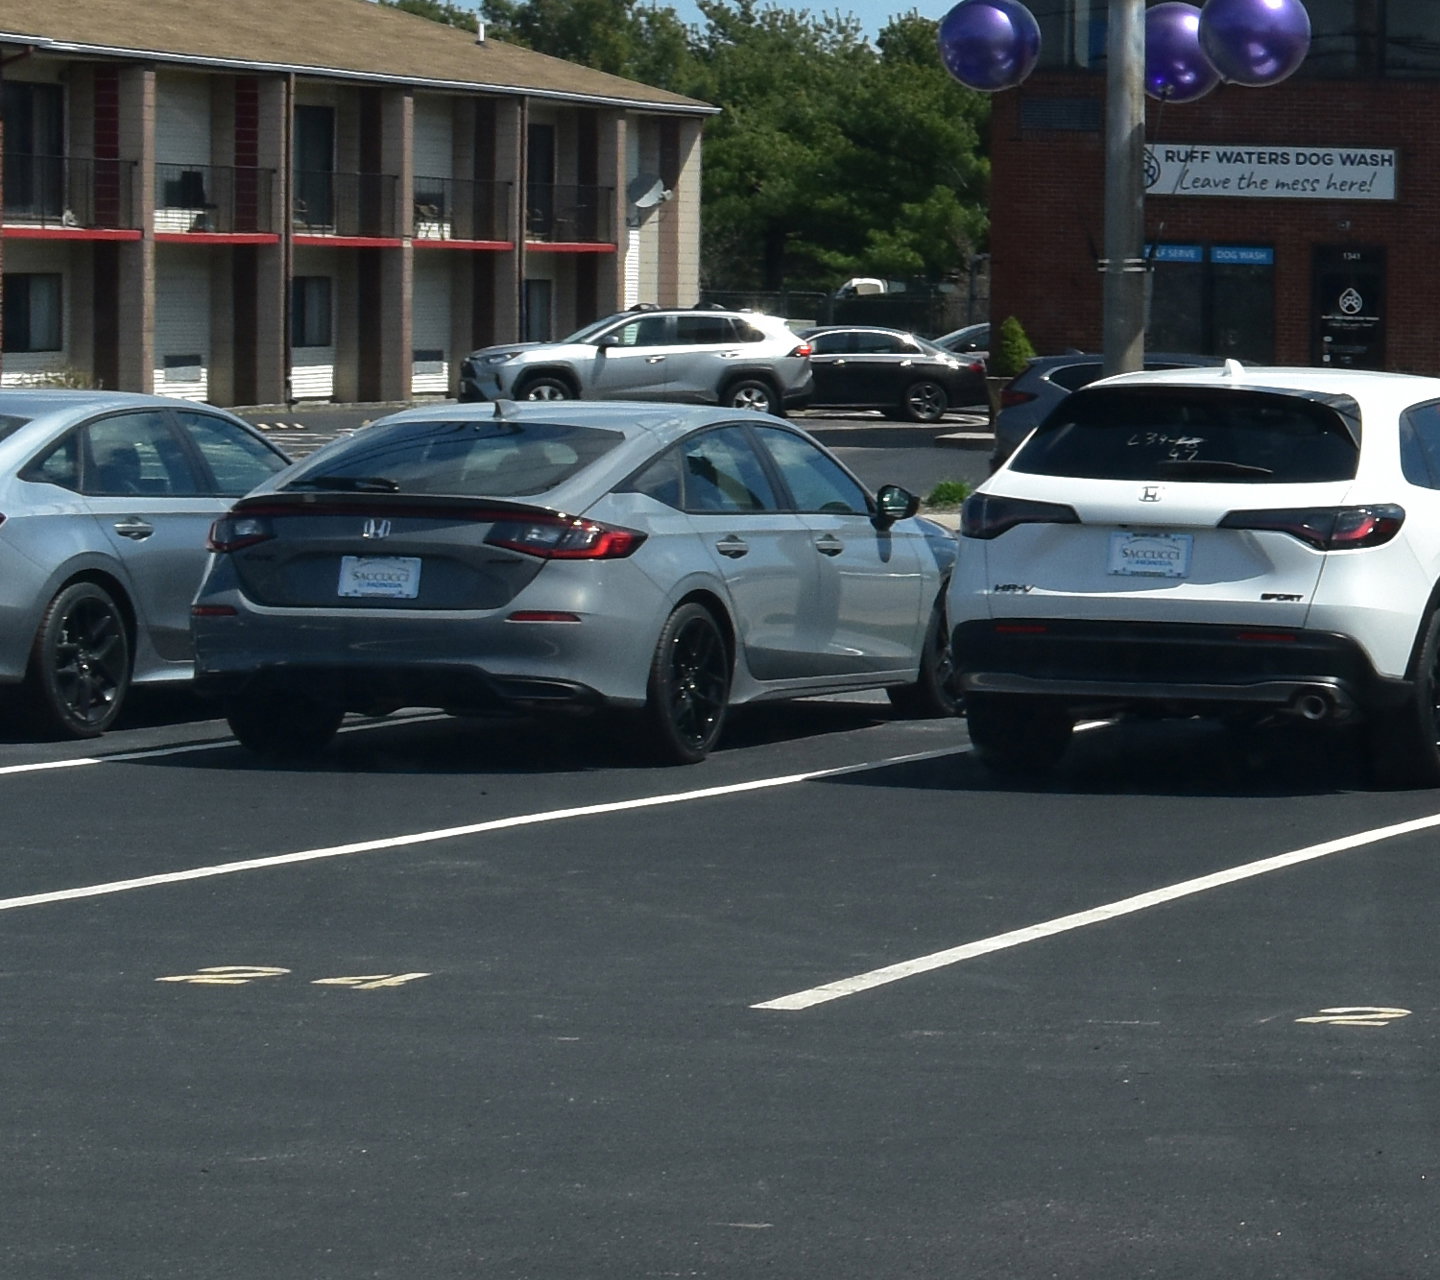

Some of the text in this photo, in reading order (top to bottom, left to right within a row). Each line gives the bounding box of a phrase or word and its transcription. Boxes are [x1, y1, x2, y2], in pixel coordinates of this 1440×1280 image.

[1164, 149, 1394, 168] RUFF WATERS DOG WASH
[1179, 169, 1377, 194] Leave the mess here!
[1122, 548, 1180, 560] SACCUCCI
